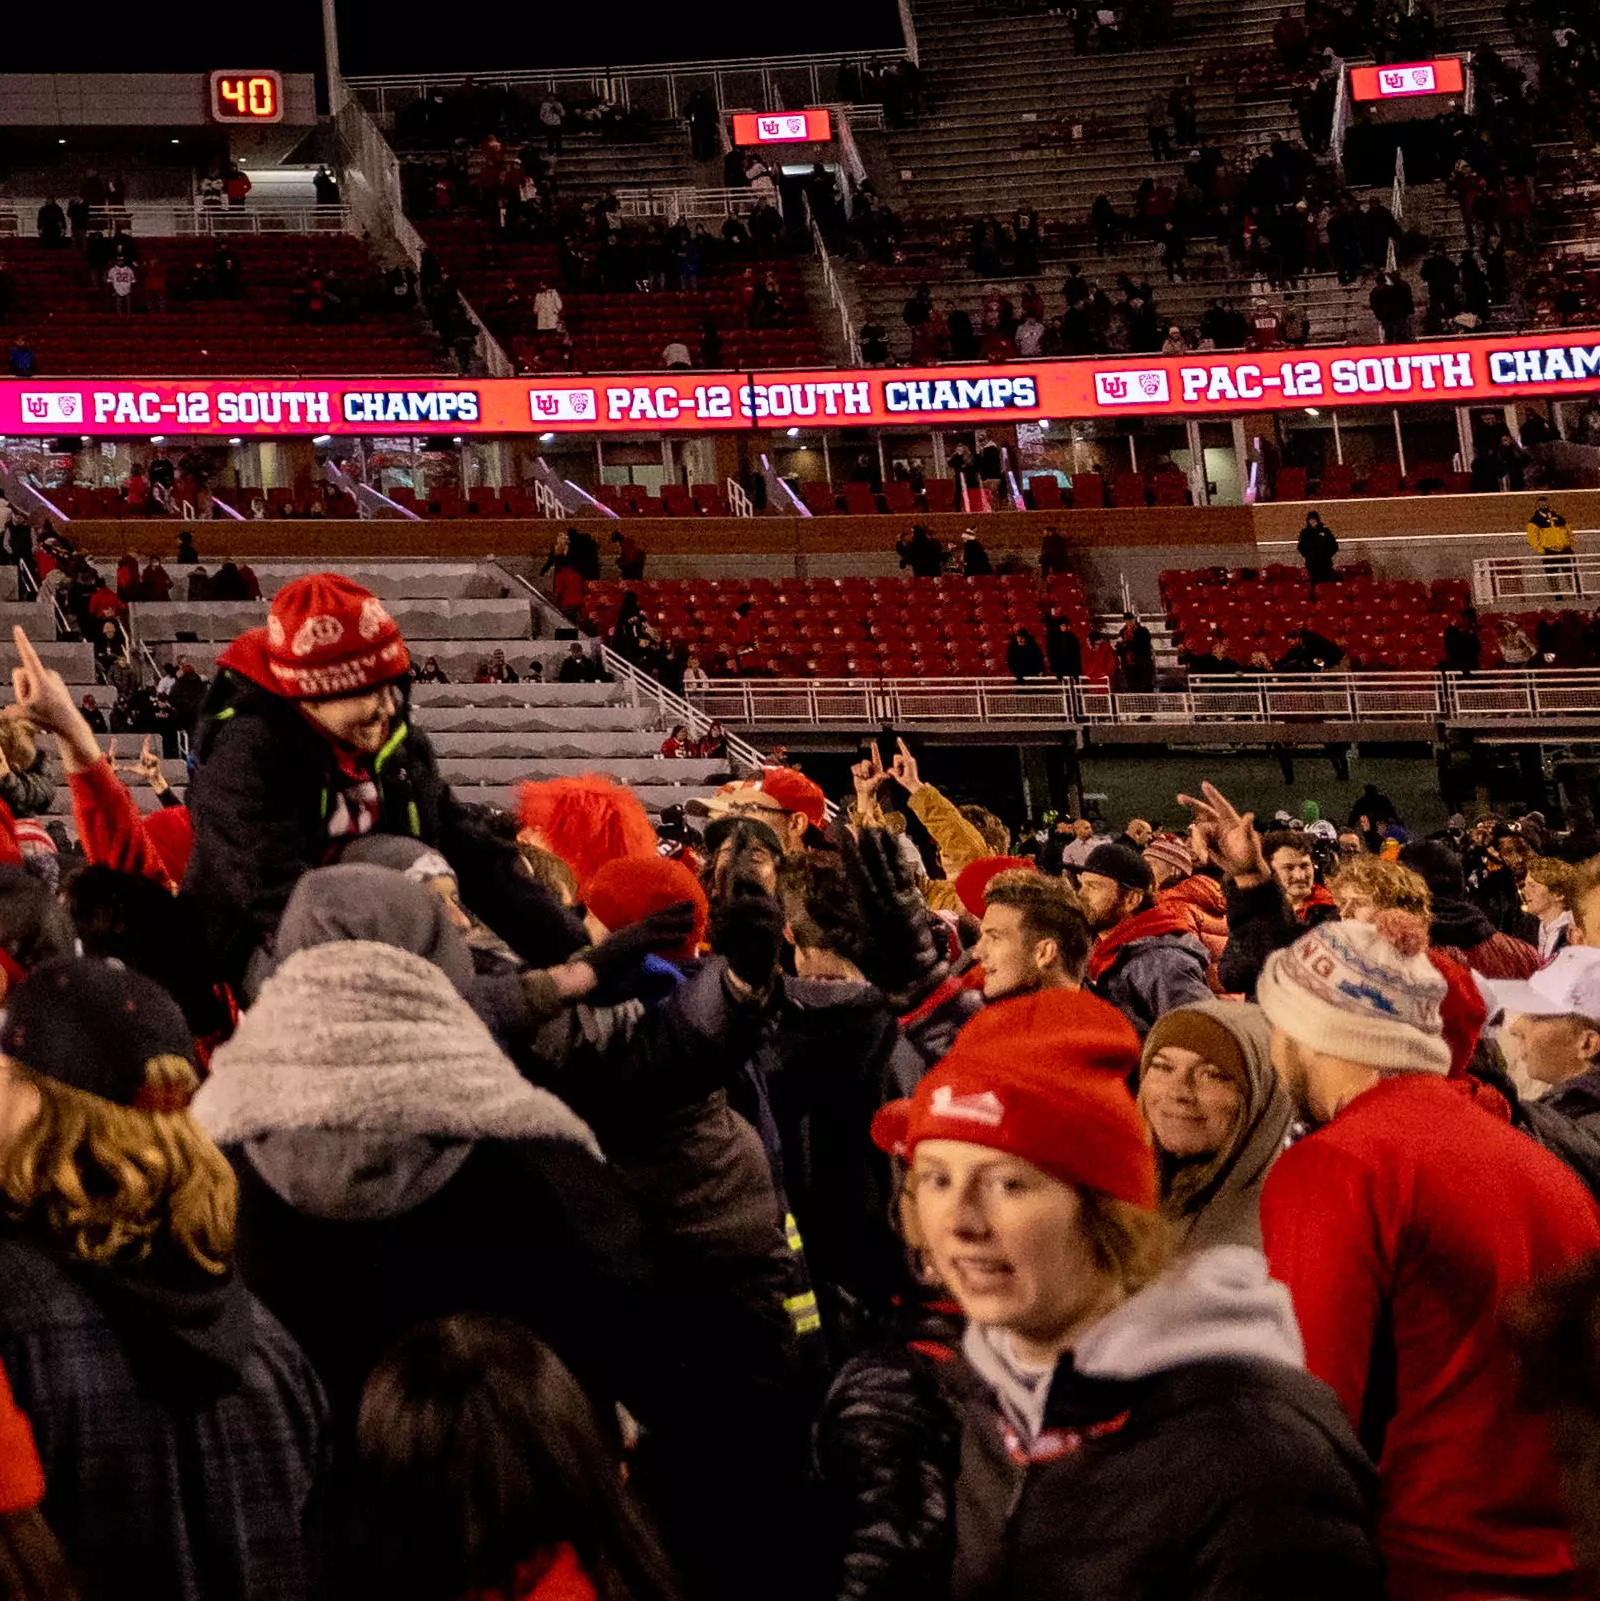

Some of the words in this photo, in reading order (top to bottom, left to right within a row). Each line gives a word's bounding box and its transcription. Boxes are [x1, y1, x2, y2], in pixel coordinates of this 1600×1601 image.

[221, 78, 272, 115] 40
[1181, 362, 1323, 401] PAC-12
[1331, 352, 1474, 392] SOUTH
[94, 392, 210, 423] PAC-12
[217, 392, 331, 422] SOUTH
[343, 393, 478, 421] CHAMPS
[606, 387, 732, 419] PAC-12
[739, 382, 871, 417] SOUTH
[885, 377, 1036, 411] CHAMPS
